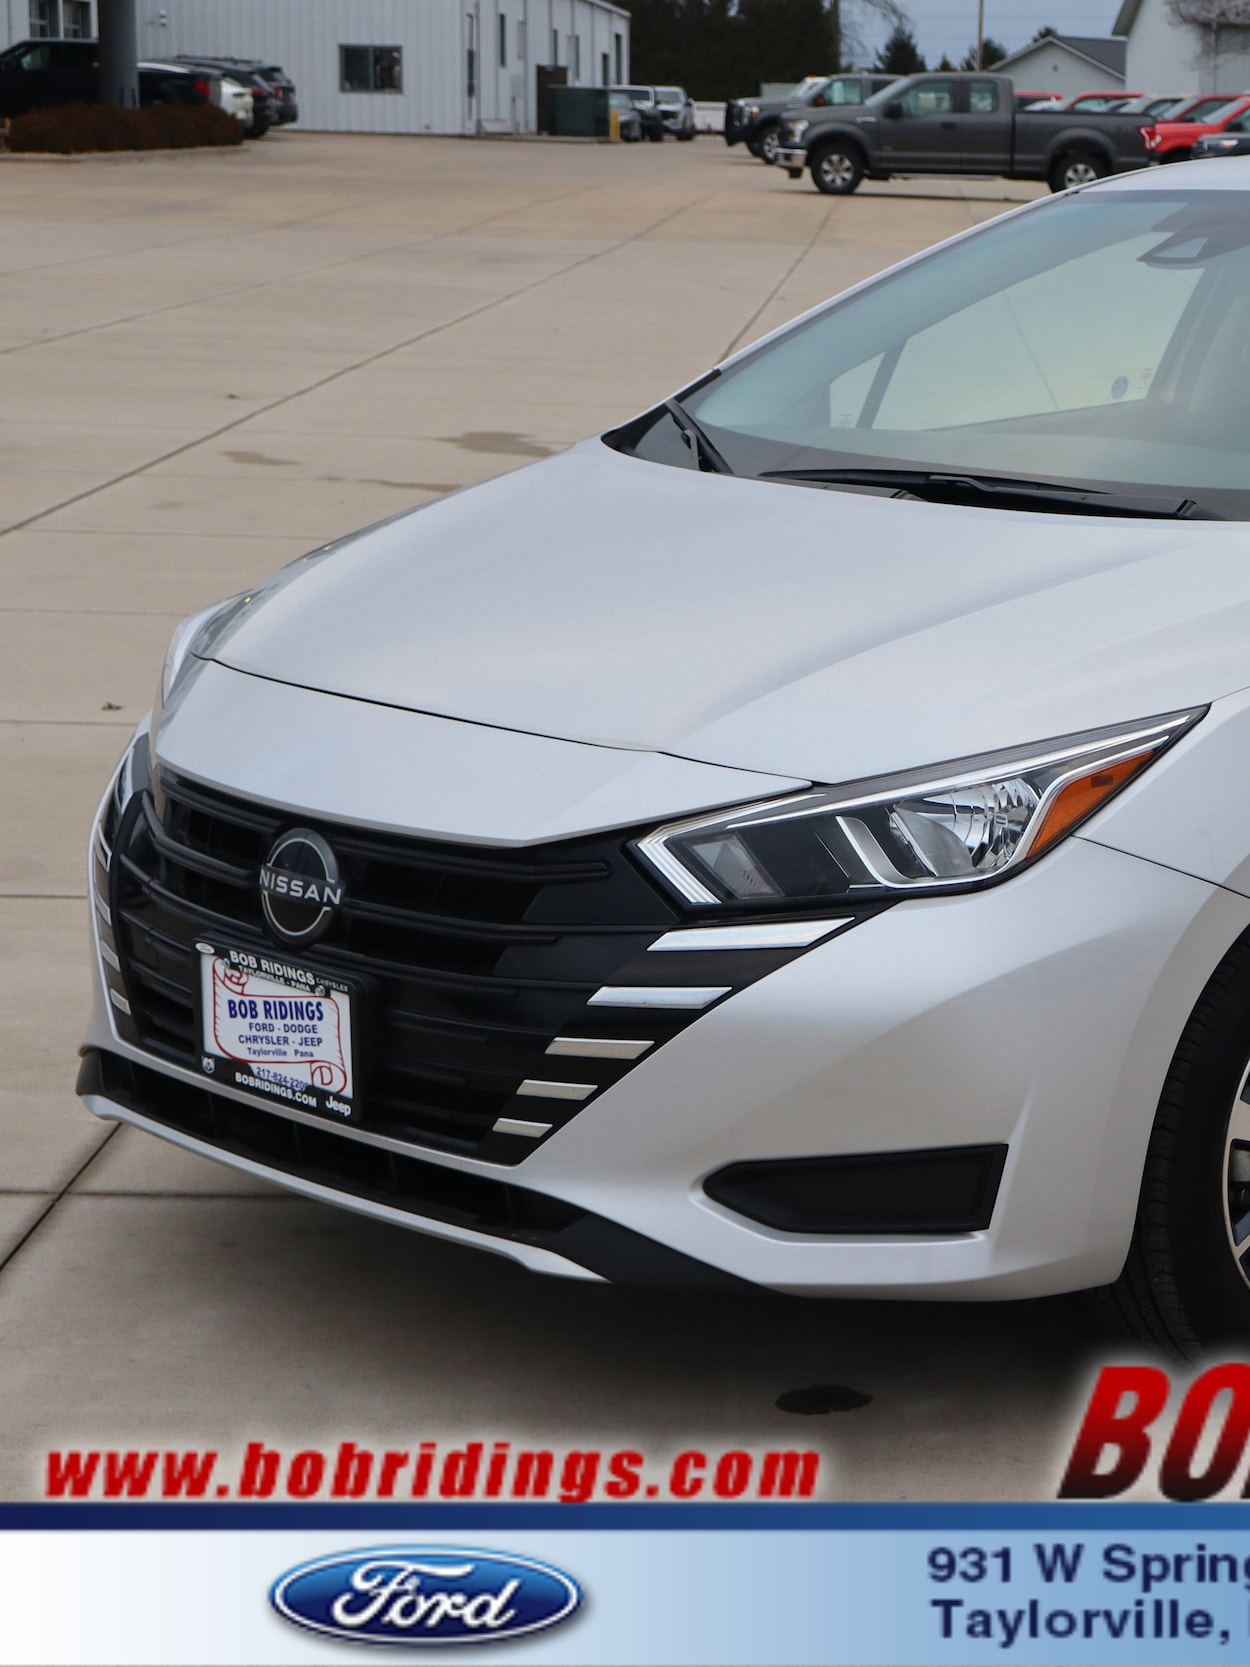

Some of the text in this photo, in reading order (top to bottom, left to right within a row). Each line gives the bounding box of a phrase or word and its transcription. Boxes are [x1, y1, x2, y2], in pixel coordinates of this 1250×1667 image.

[260, 869, 341, 905] NISSAN
[229, 950, 316, 986] BOB RIDINGS
[228, 999, 324, 1021] BOB RIDINGS
[249, 1022, 275, 1032] FORD
[283, 1023, 318, 1034] DODGE
[238, 1034, 290, 1046] CHRYSLER
[298, 1036, 323, 1047] JEEP
[247, 1046, 314, 1058] Taylorville Pana
[235, 1072, 317, 1108] BOBRIDINGS.COM
[325, 1096, 352, 1117] Jeep
